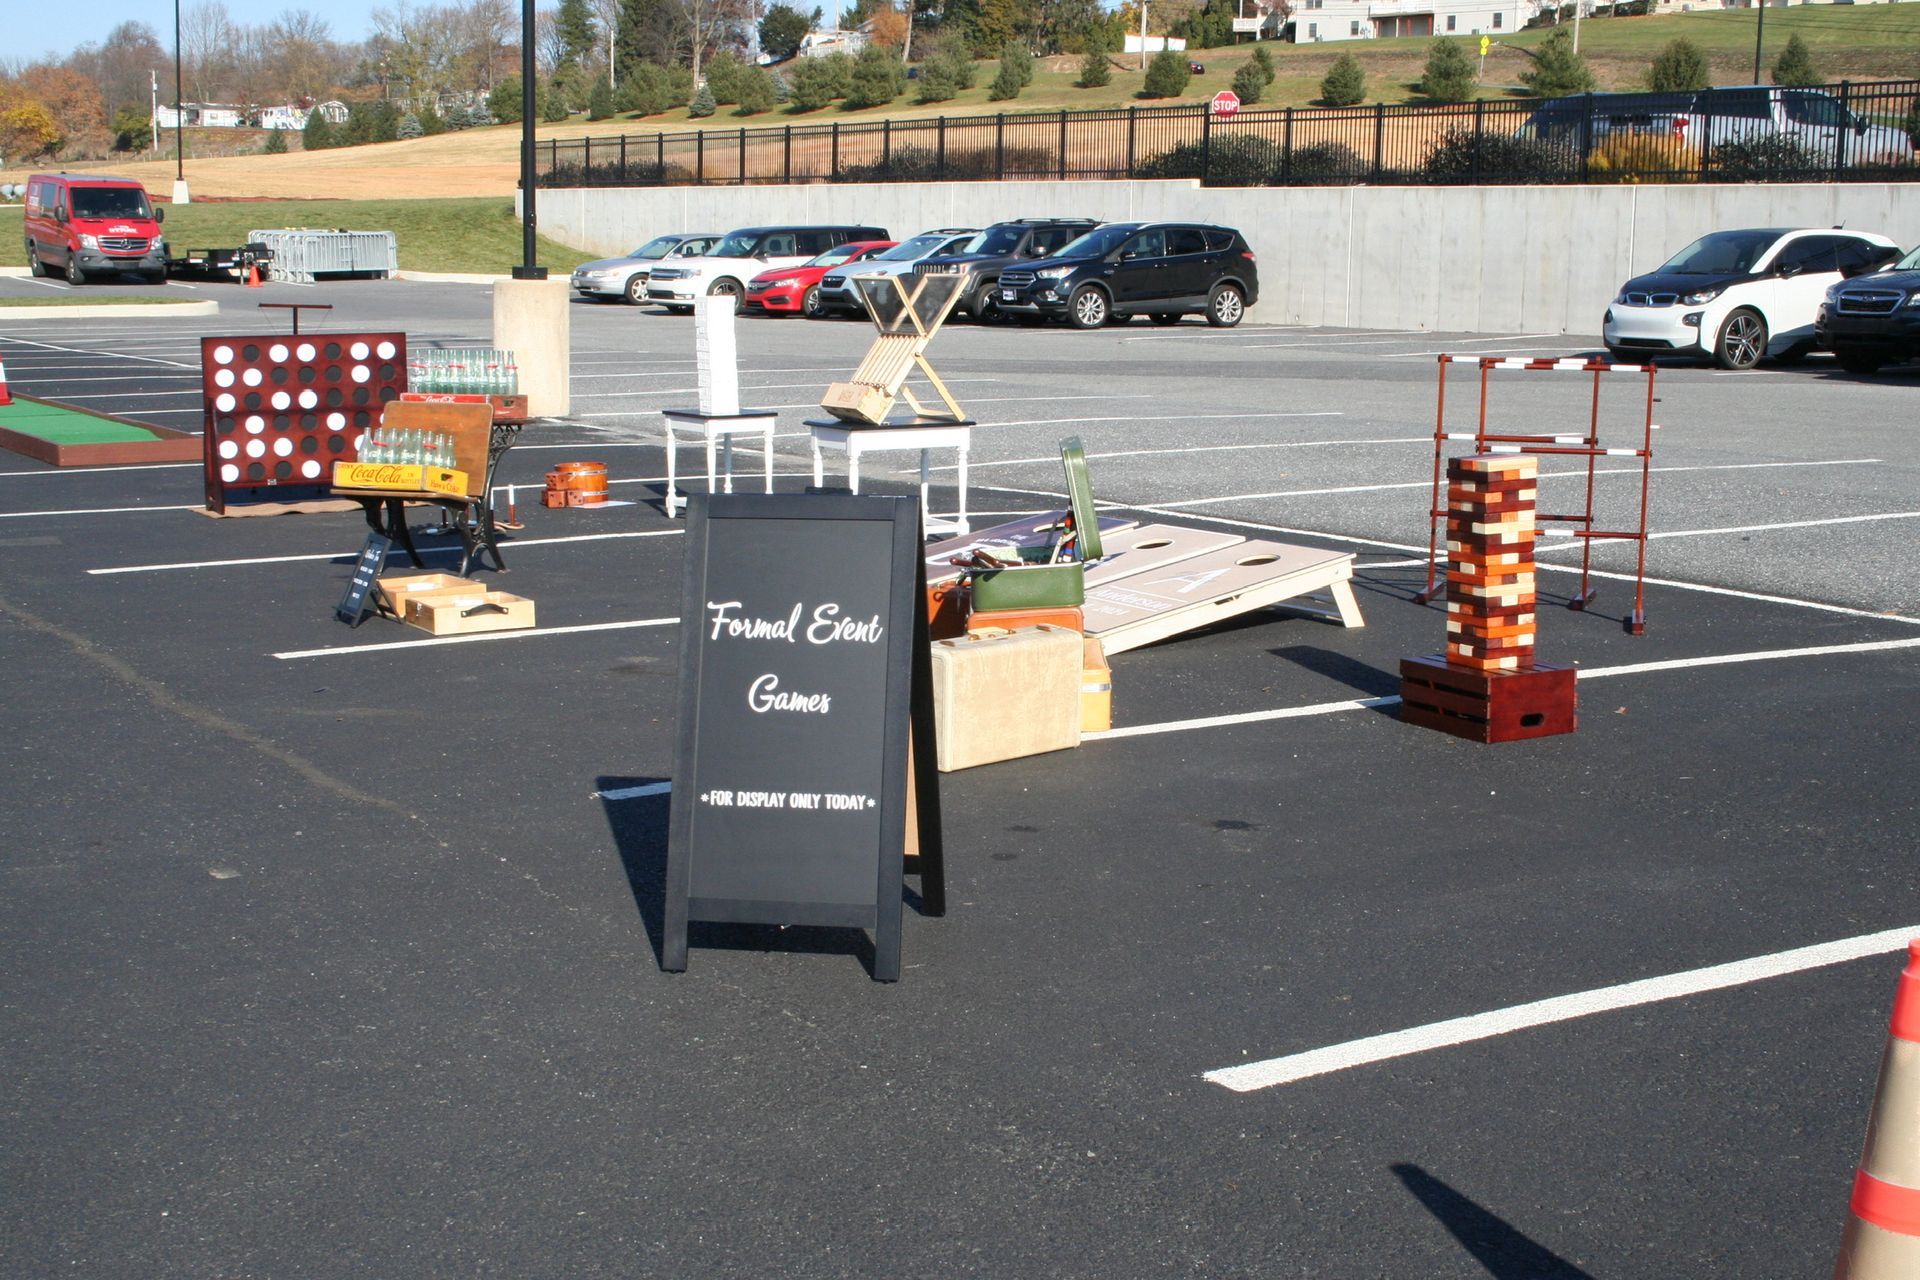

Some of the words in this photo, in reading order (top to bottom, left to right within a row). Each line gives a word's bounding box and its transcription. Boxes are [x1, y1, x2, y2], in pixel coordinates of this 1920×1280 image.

[1214, 100, 1238, 110] STOP
[707, 601, 802, 643] Formal
[807, 603, 883, 644] Event
[748, 674, 831, 713] Games
[737, 791, 786, 808] DISPLAY
[789, 793, 821, 809] ONLY
